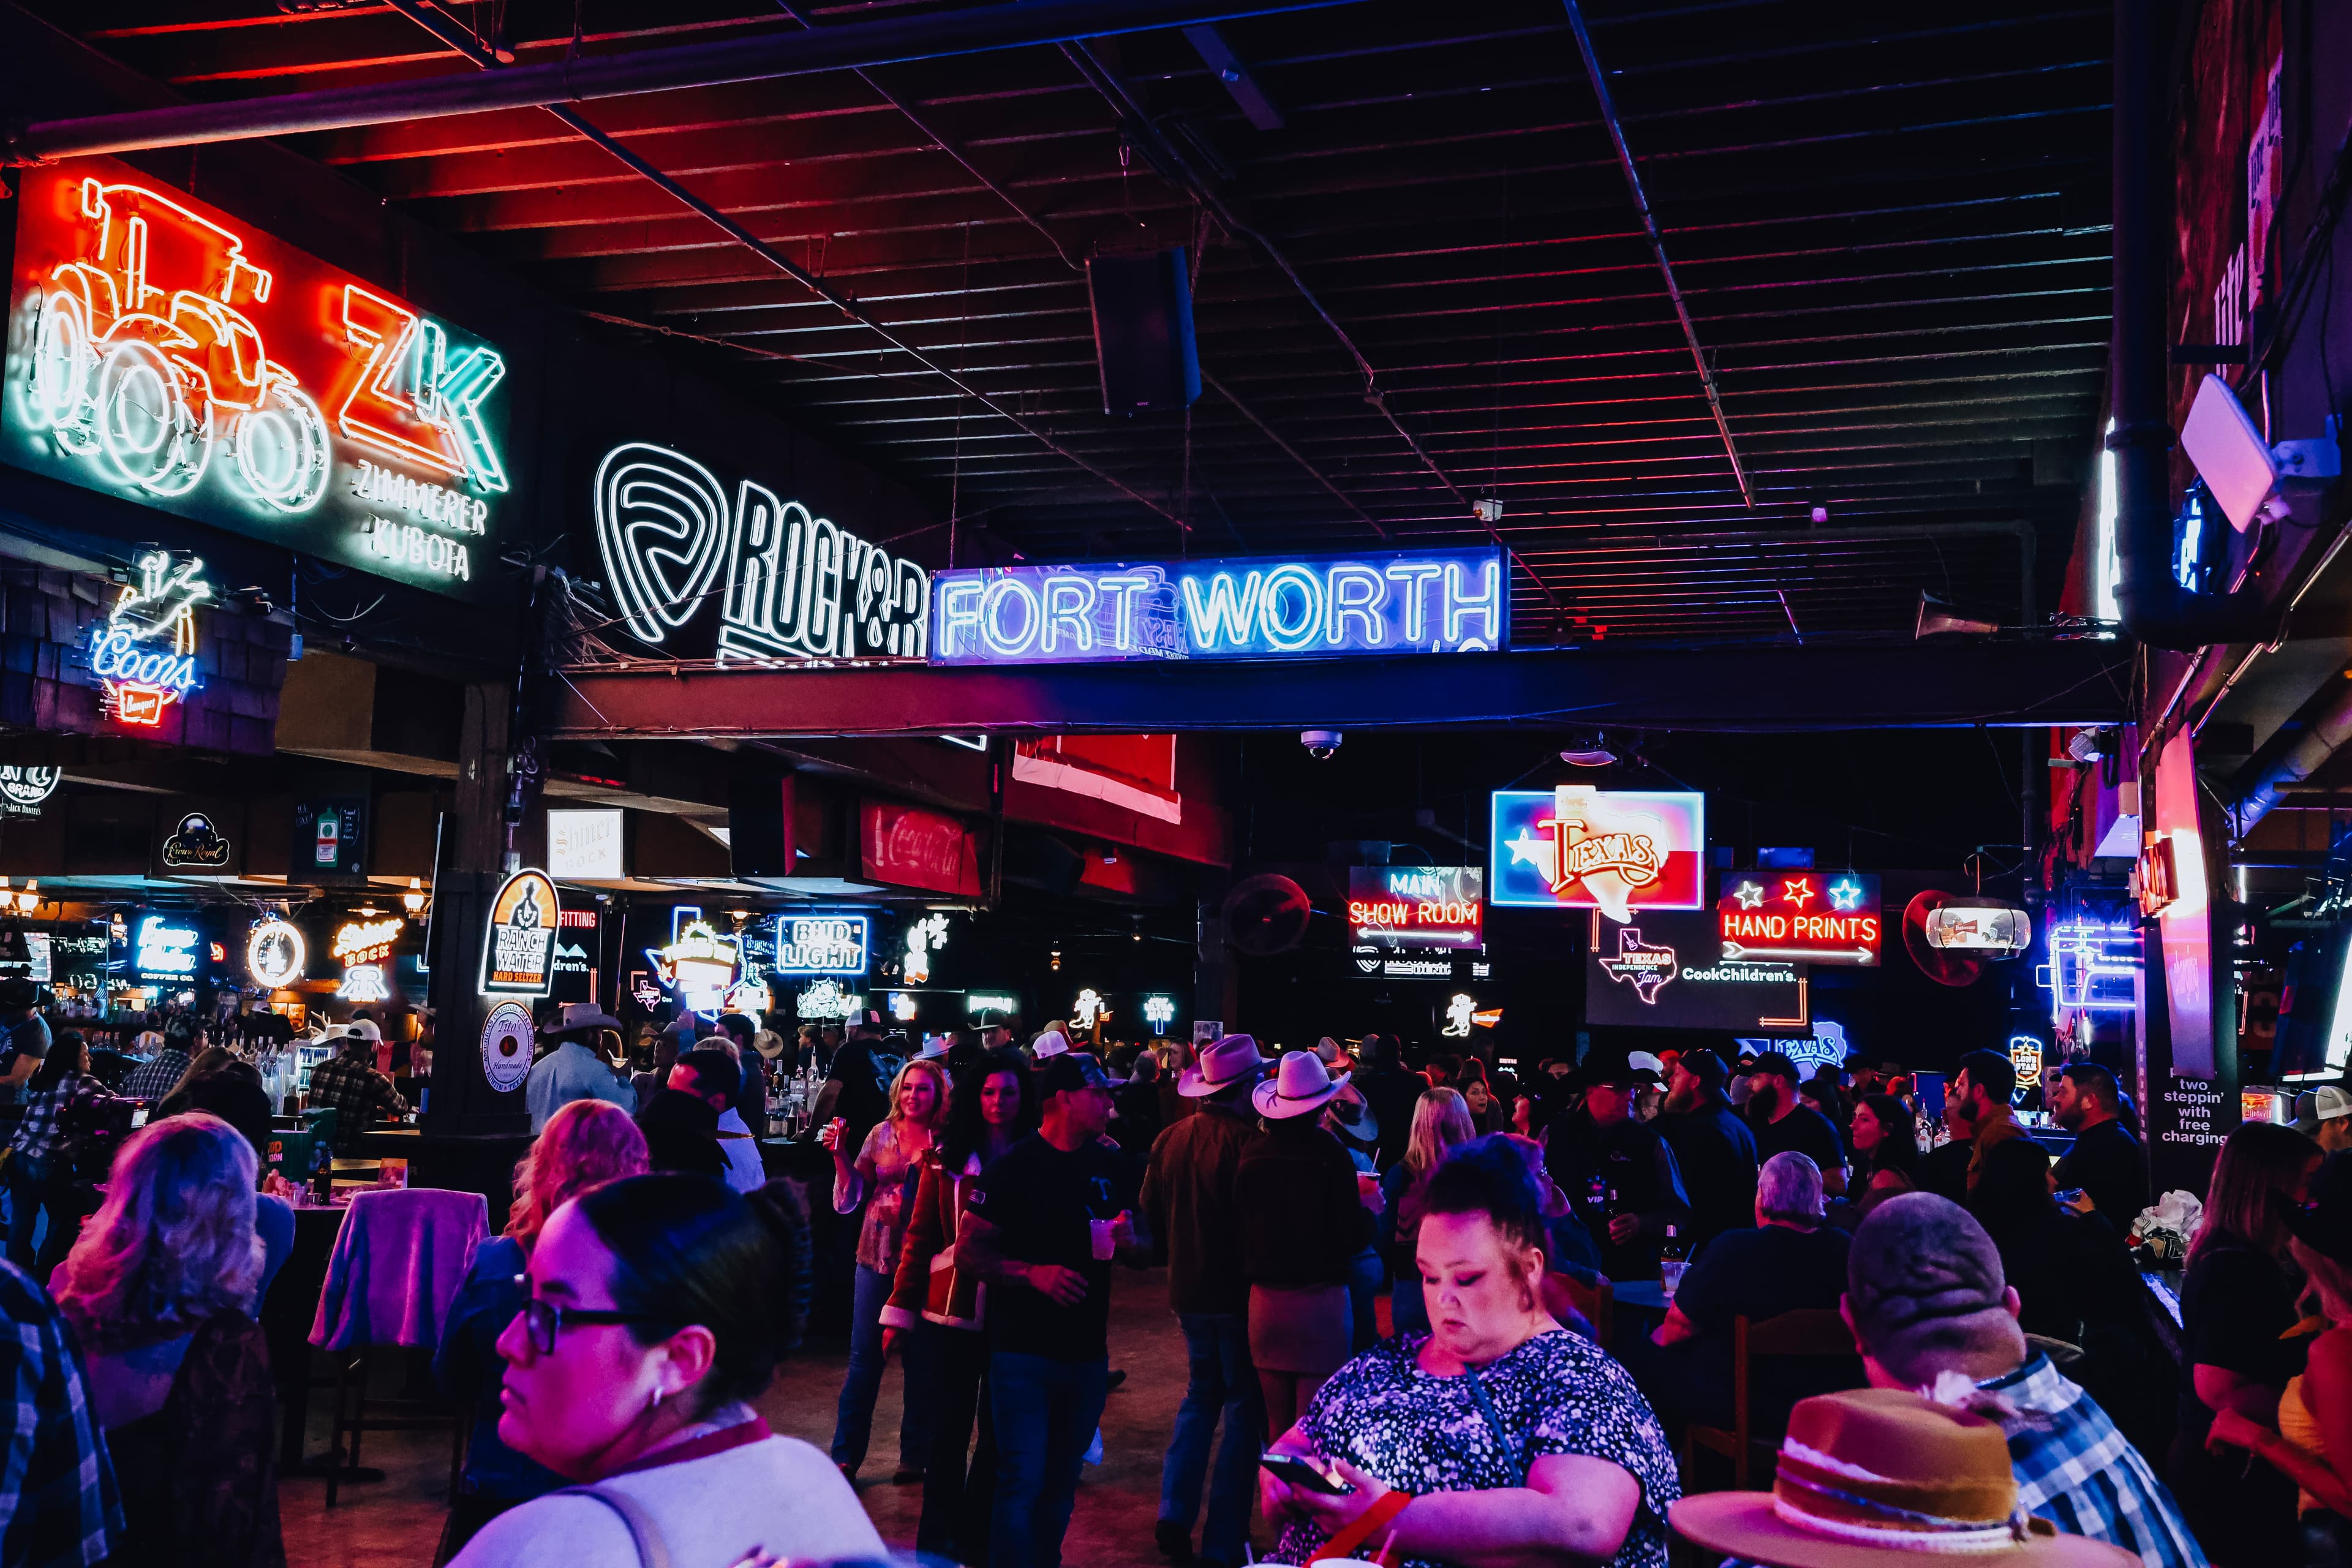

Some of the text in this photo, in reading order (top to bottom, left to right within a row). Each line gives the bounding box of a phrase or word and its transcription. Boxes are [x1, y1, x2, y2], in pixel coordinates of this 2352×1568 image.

[357, 459, 488, 537] ZIMMERER
[370, 513, 469, 581] KUBOTA
[940, 576, 1149, 656] FORT
[1183, 562, 1499, 650] WORTH
[94, 631, 195, 689] Coors
[126, 695, 156, 714] Banquet
[7, 782, 45, 797] BRAND
[168, 842, 223, 861] Crown Royal
[1537, 819, 1659, 893] TEXAS
[1390, 874, 1441, 895] MAIN
[1351, 902, 1477, 924] SHOW ROOM
[793, 921, 851, 944] BUD
[1724, 915, 1877, 941] HAND PRINTS
[497, 929, 548, 952] RANCH
[345, 945, 390, 968] BOCK
[496, 950, 545, 973] WATER
[782, 943, 861, 968] LIGHT
[1623, 953, 1671, 966] TEXAS
[493, 971, 542, 983] HARD SELTZER
[1637, 970, 1662, 987] Jam
[493, 1005, 518, 1020] ORIGINAL
[497, 1019, 522, 1033] Tito's
[492, 1058, 522, 1070] Handmade
[486, 1071, 526, 1090] AUSTIN TEXAS
[2179, 1079, 2208, 1091] two
[2164, 1091, 2224, 1105] steppin'
[2178, 1106, 2211, 1118] with
[2179, 1118, 2211, 1131] free
[2162, 1130, 2228, 1146] charging
